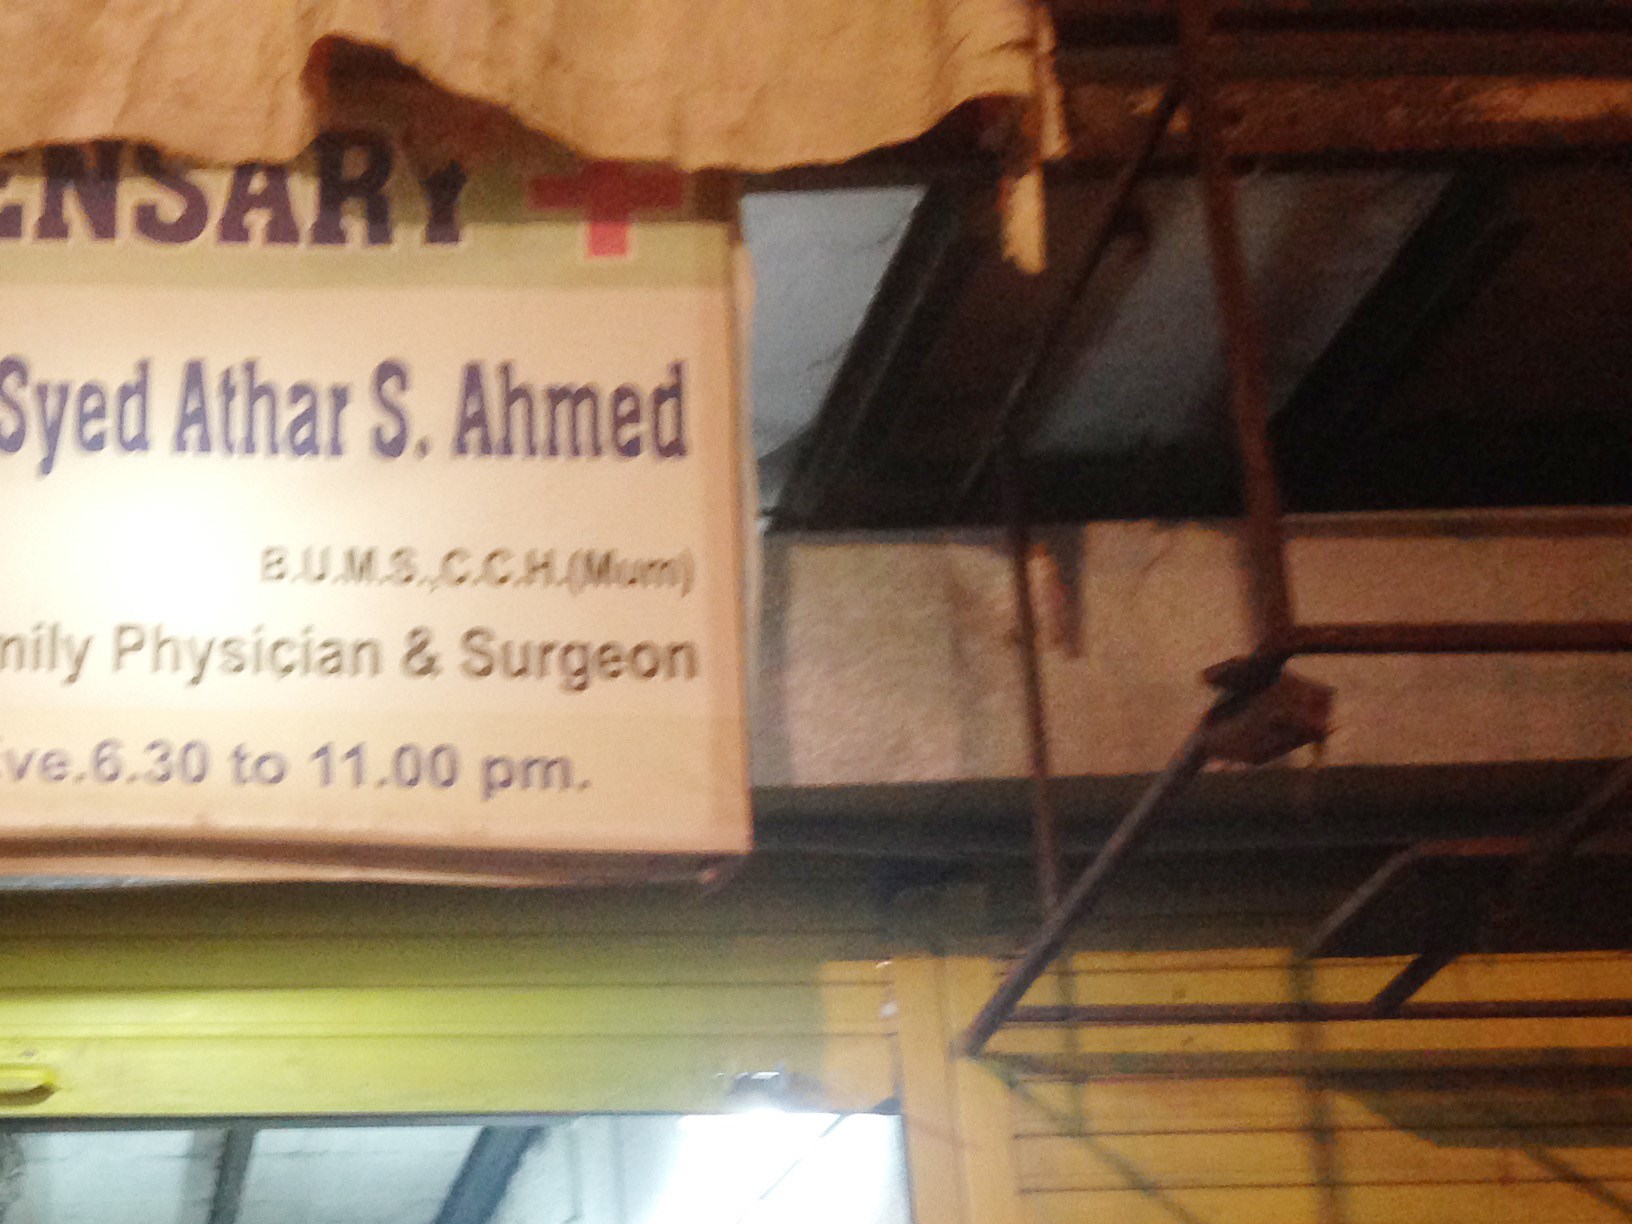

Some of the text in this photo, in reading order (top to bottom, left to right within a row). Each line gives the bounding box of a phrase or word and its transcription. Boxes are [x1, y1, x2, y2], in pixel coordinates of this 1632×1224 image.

[172, 356, 352, 459] Athar
[370, 357, 432, 460] S.
[449, 359, 690, 463] Ahmed
[112, 620, 386, 689] Physician
[400, 626, 442, 682] &
[457, 626, 701, 694] Surgeon
[230, 742, 291, 788] to
[308, 740, 460, 791] 11.00
[480, 748, 594, 799] pm.
